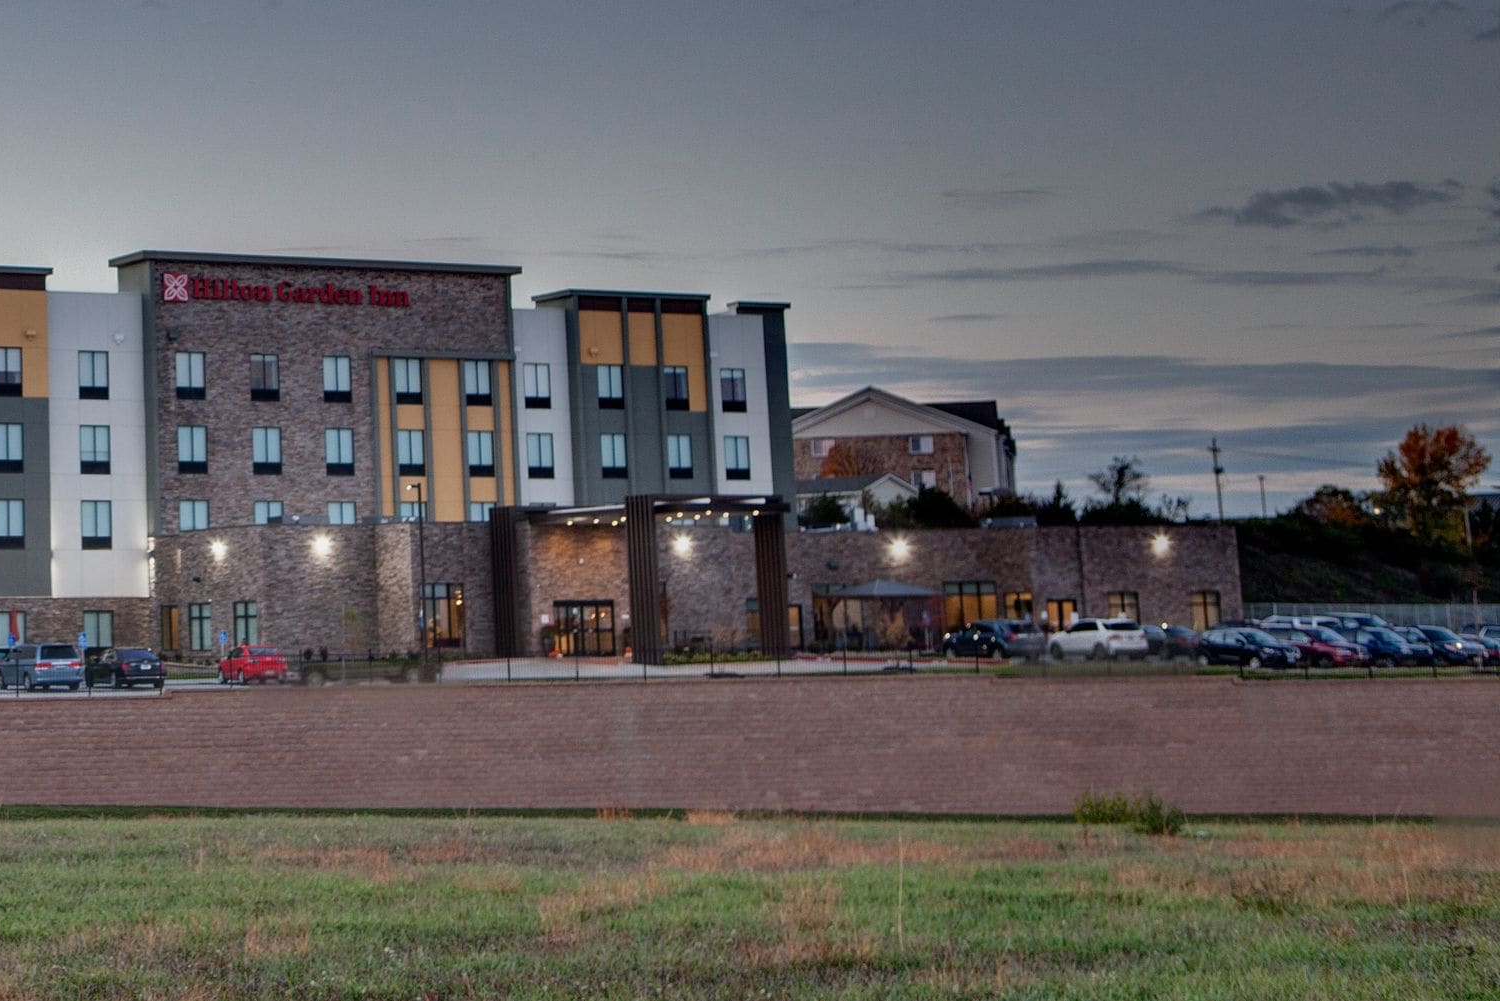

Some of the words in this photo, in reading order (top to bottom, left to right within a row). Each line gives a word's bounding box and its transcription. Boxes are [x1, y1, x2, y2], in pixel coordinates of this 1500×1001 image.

[192, 277, 273, 302] Hilton
[277, 281, 363, 305] Garden
[368, 284, 410, 307] Inn
